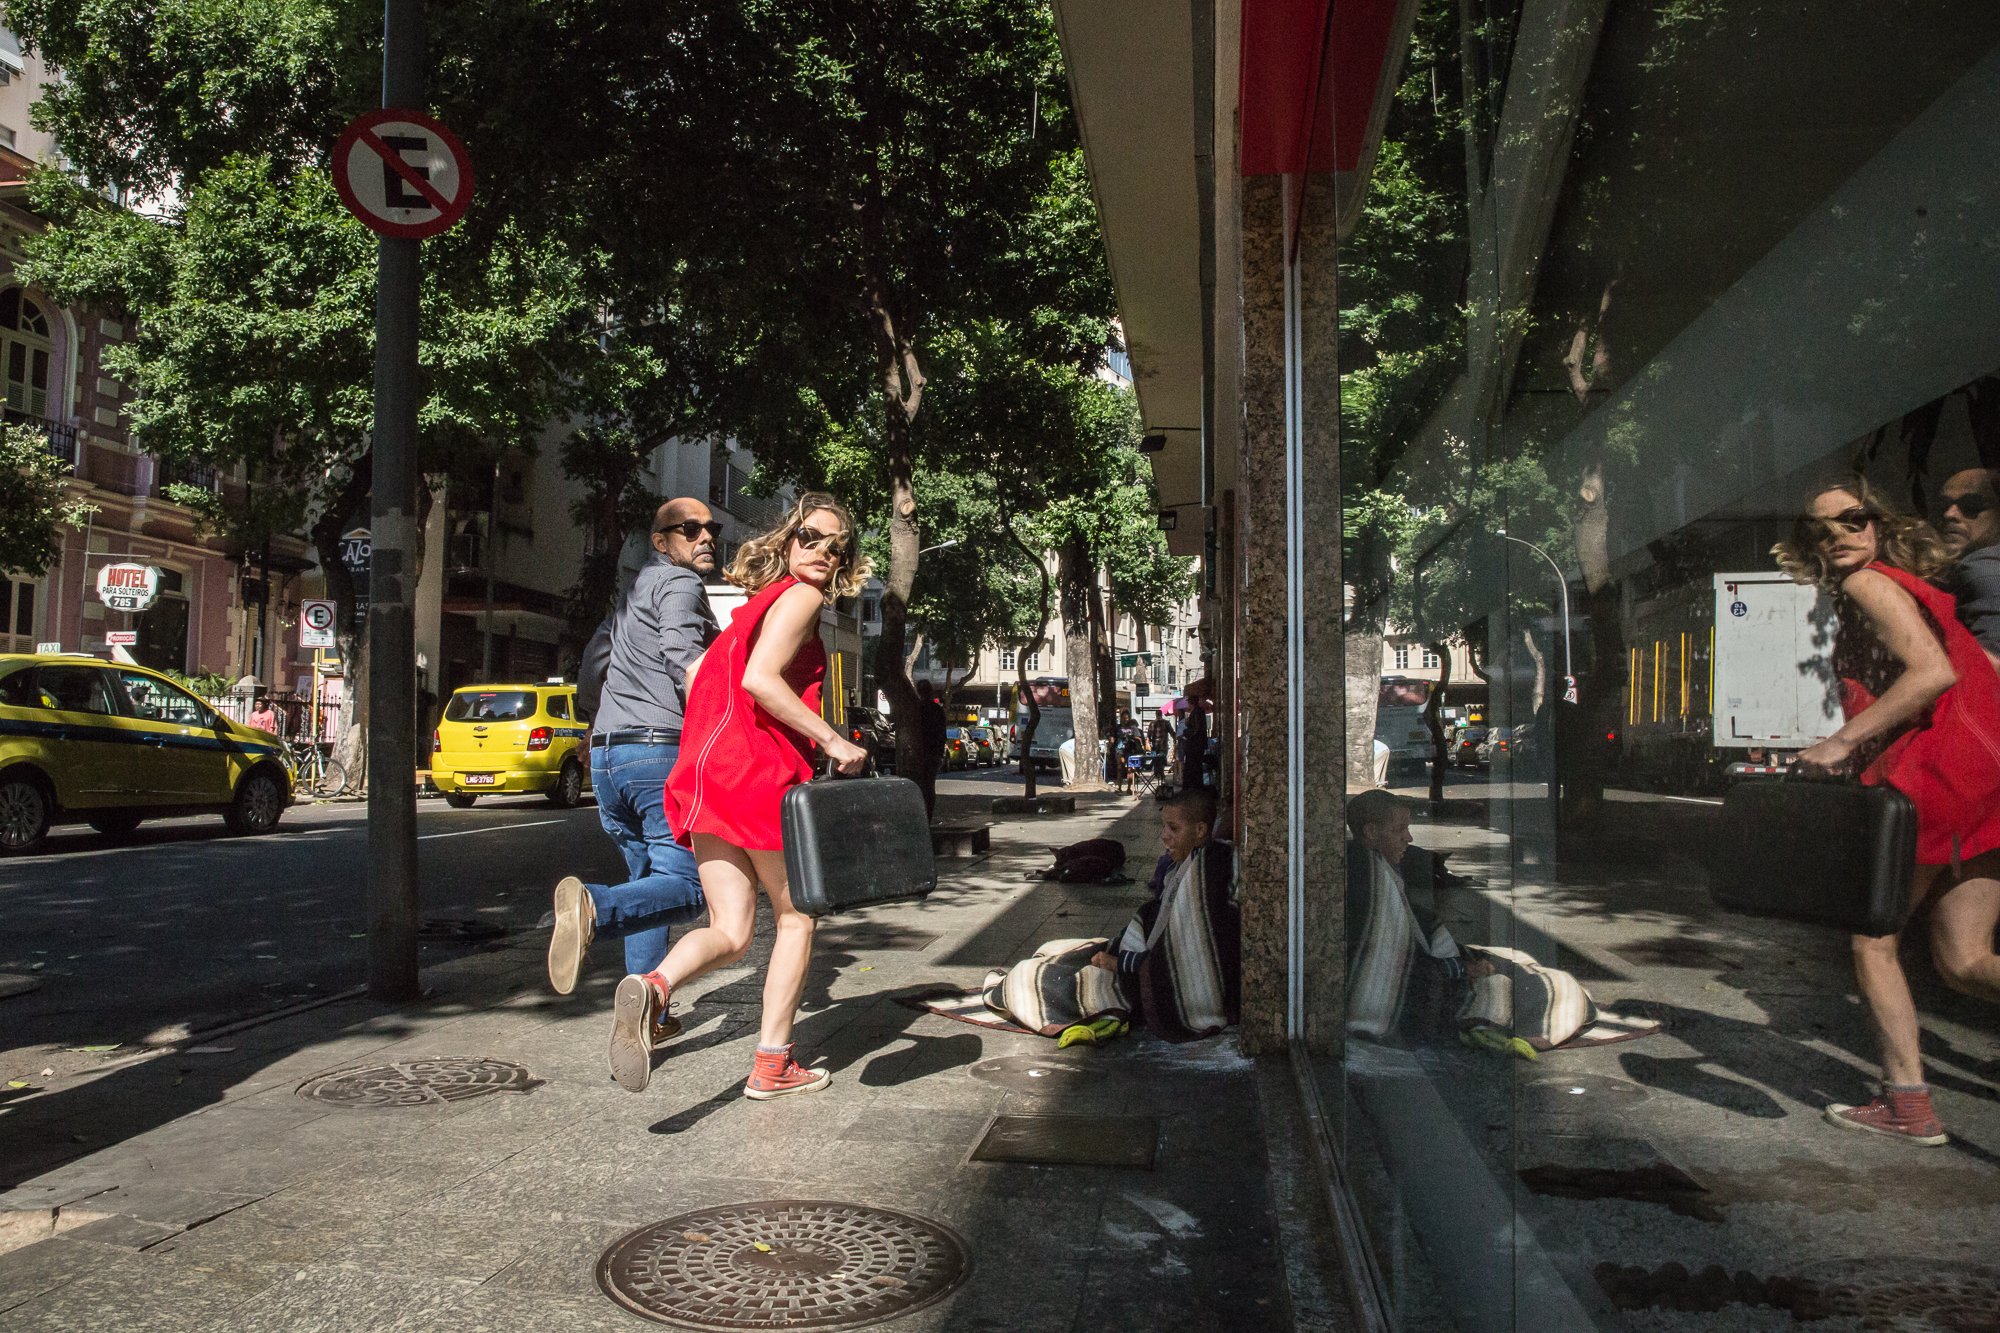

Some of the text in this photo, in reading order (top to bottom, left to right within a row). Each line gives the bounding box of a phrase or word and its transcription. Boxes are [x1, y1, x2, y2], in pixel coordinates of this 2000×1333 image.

[381, 136, 432, 209] E
[107, 568, 149, 589] HOTEL
[102, 586, 149, 597] PARA SOLTEIROS
[113, 597, 132, 607] 785
[314, 610, 324, 624] E
[39, 643, 60, 654] TAXI
